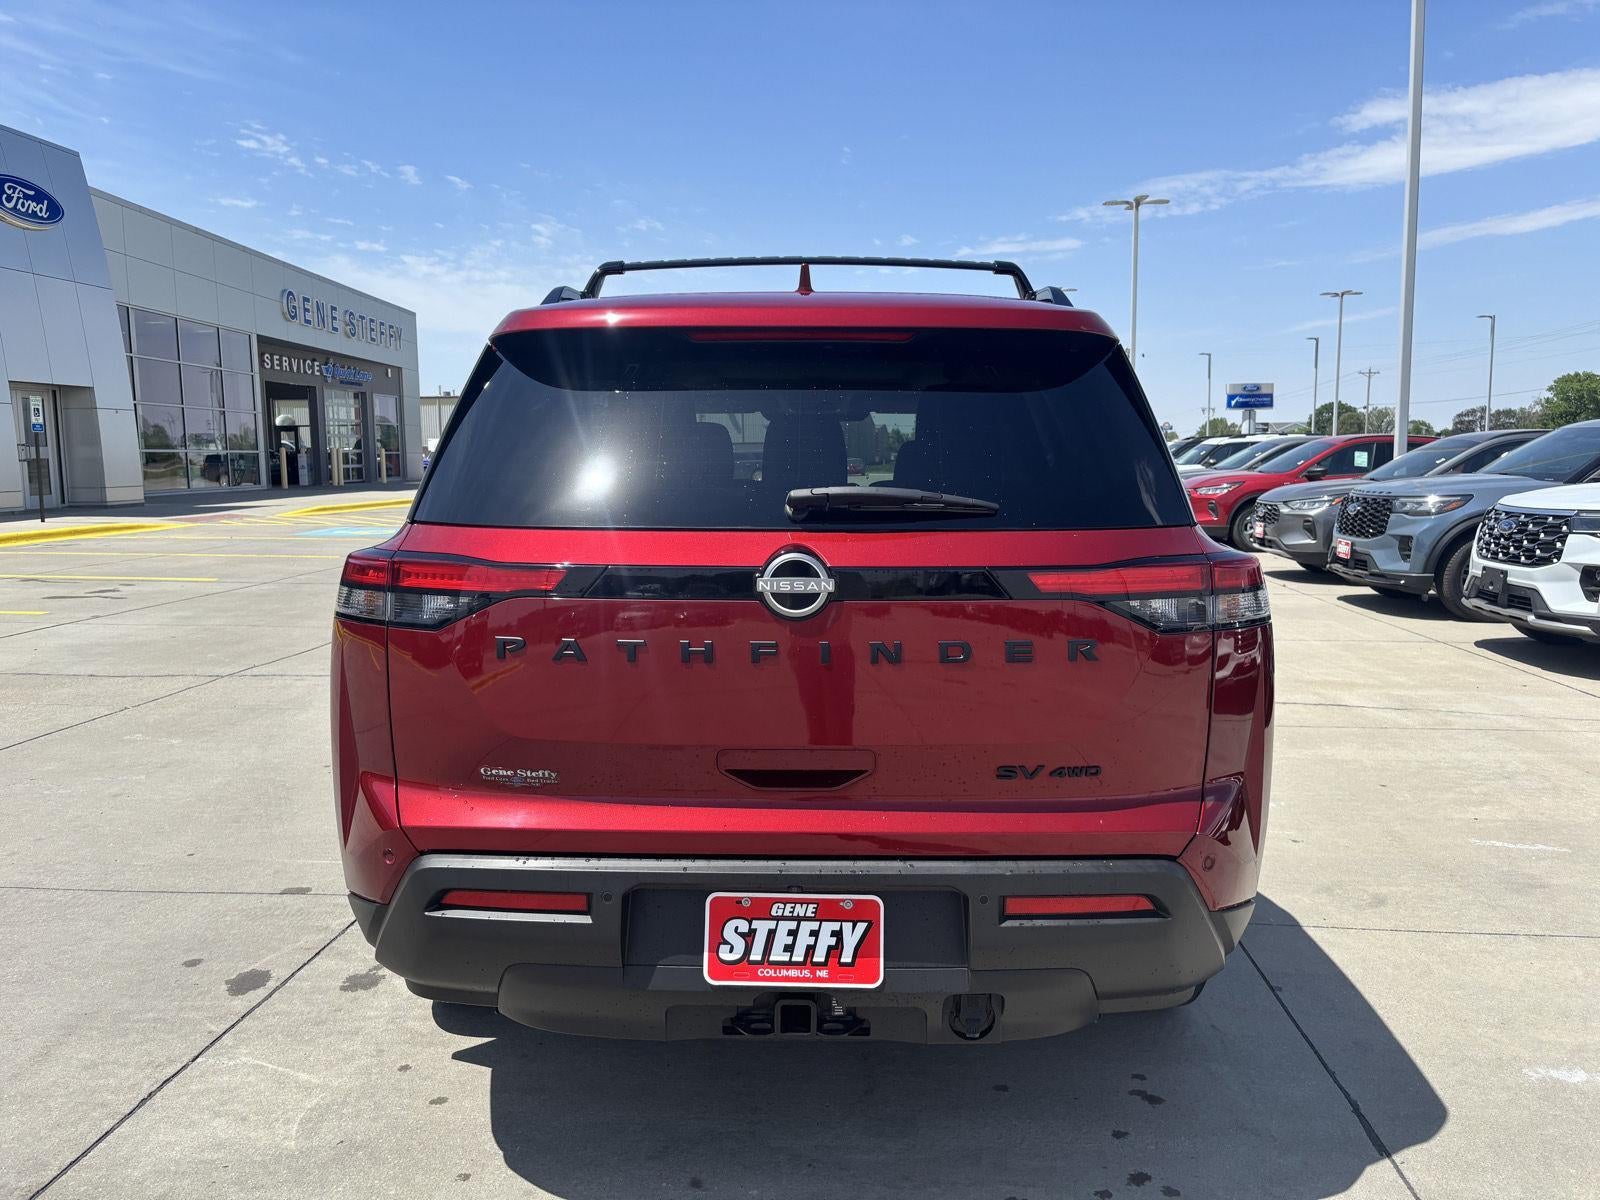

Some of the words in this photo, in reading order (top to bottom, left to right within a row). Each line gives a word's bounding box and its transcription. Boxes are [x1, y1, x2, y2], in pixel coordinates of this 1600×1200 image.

[2, 182, 49, 218] Ford
[282, 289, 339, 333] GENE
[344, 309, 402, 351] STEFFY
[263, 353, 321, 376] SERVICE
[759, 581, 833, 591] NISSAN
[494, 635, 1099, 665] PATHFINDER
[480, 766, 514, 776] Gene
[517, 769, 557, 779] Steffy
[996, 764, 1045, 780] SV
[1049, 765, 1101, 778] 4WD
[769, 902, 819, 918] GENE
[717, 918, 871, 966] STEFFY
[757, 968, 813, 978] COLUMBUS,
[816, 969, 829, 978] NE
